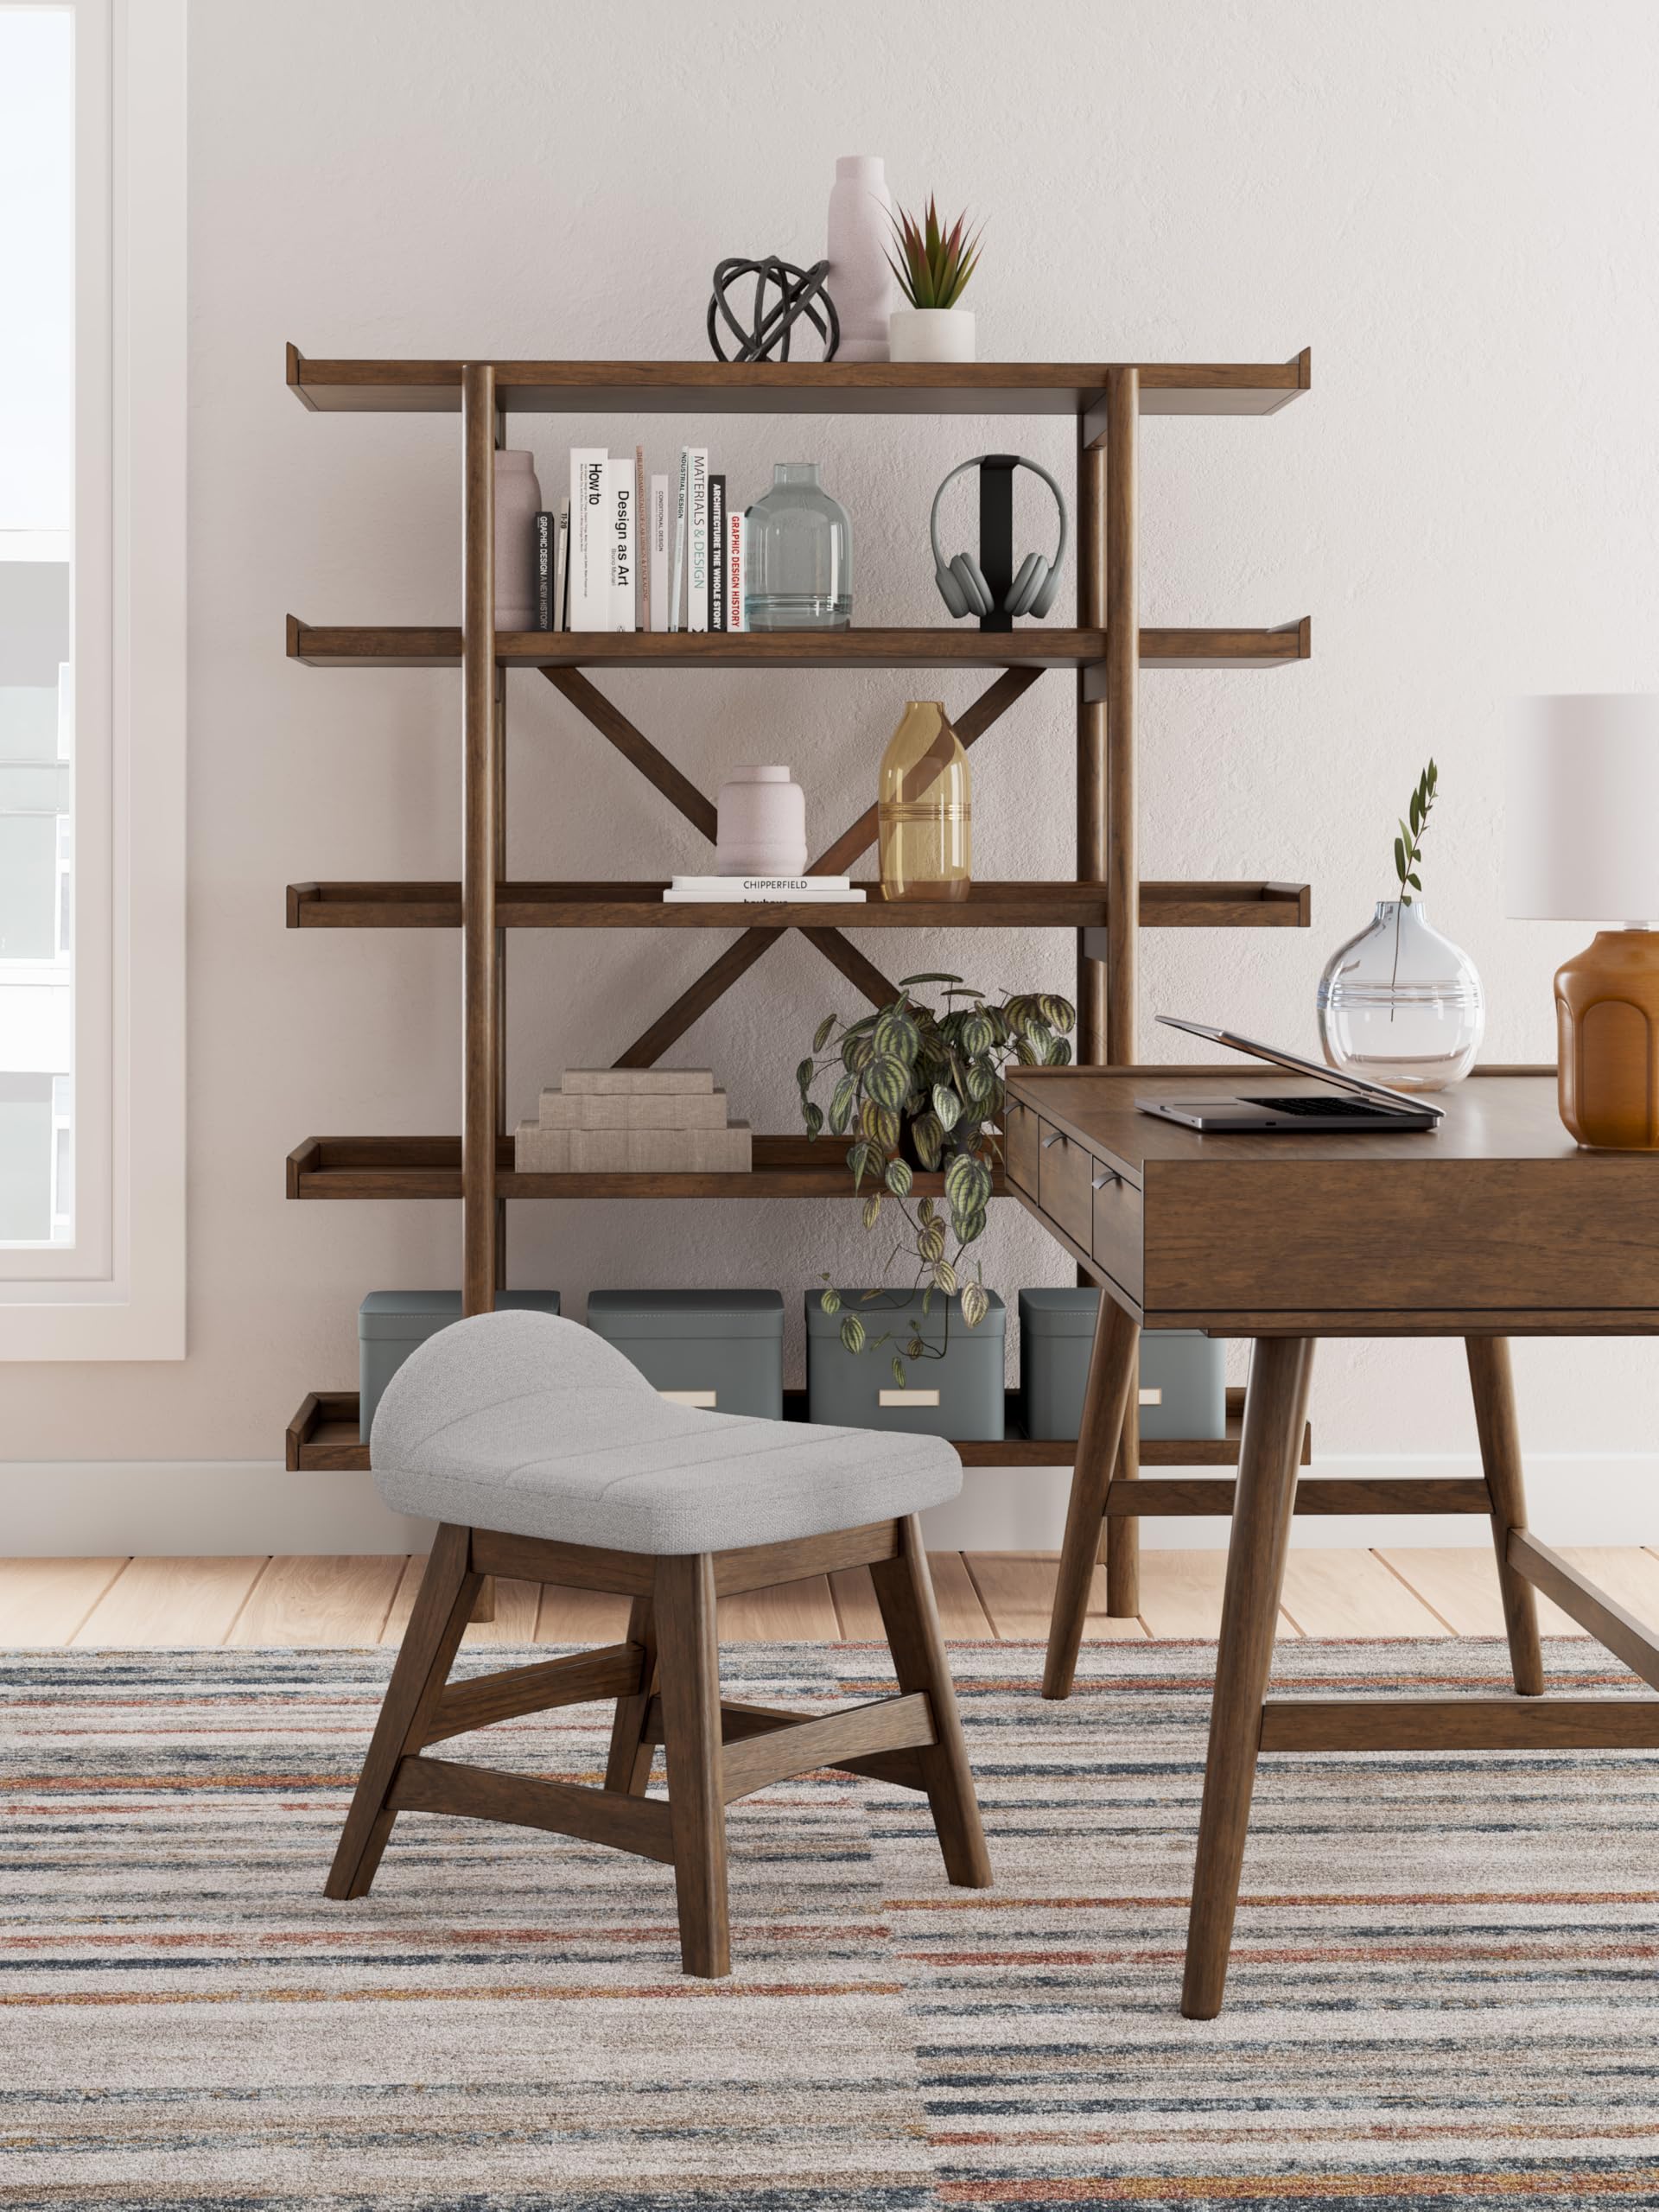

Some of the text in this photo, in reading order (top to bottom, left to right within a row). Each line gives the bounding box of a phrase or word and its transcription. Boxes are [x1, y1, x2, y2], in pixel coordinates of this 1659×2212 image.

[588, 463, 602, 505] How to
[539, 516, 548, 547] GRAPHIC
[614, 491, 629, 586] Design as Art
[694, 455, 704, 588] MATERIALS & DESIGN
[539, 550, 548, 575] DESIGN
[713, 484, 721, 629] ARCHITECTURE THE WHOLE STORY
[731, 516, 741, 626] GRAPHIC DESIGN HISTORY
[539, 582, 548, 598] NEW
[539, 599, 548, 630] HISTORY
[743, 880, 807, 889] CHIPPERFIELD
